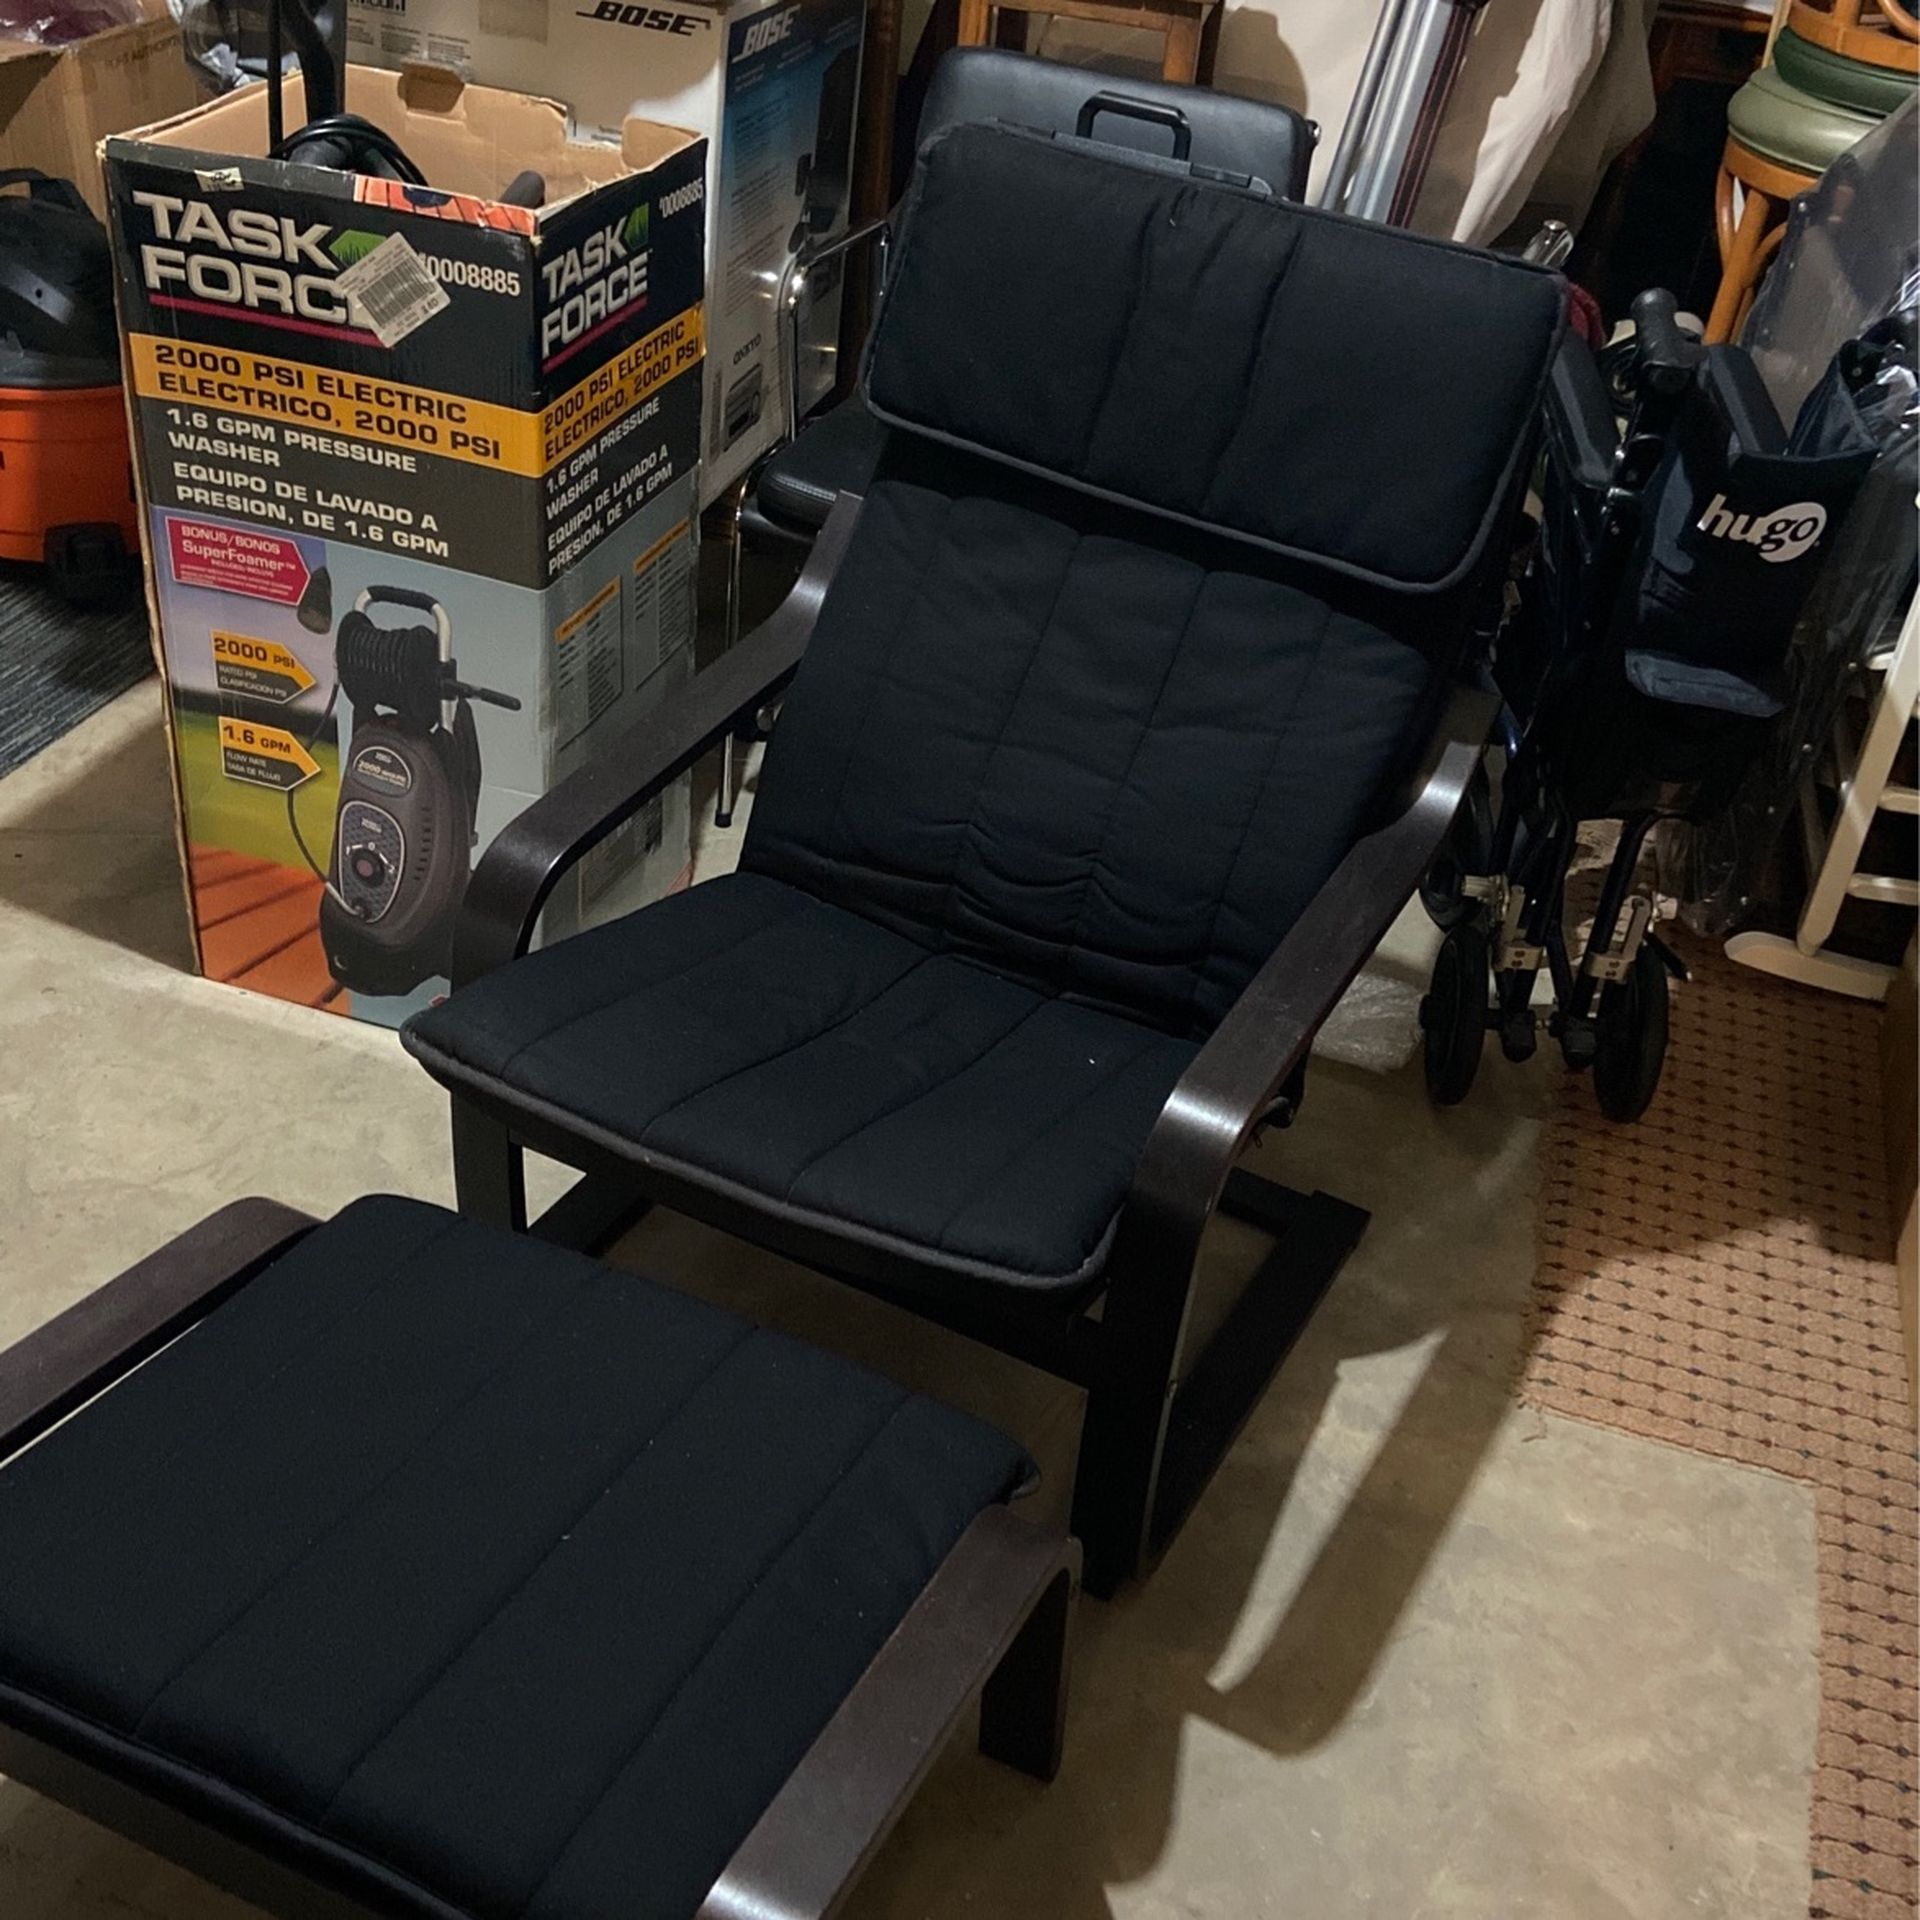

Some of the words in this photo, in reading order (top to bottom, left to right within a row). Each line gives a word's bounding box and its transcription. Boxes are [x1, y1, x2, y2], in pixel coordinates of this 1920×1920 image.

[577, 1, 711, 36] BOSE
[732, 4, 801, 62] BOSE
[132, 190, 339, 271] TASK
[542, 215, 628, 303] TASK
[542, 251, 649, 359] FORCE
[155, 344, 241, 377] 2000
[254, 364, 305, 390] PSI
[317, 375, 467, 424] ELECTRIC
[545, 390, 585, 436] 2000
[589, 367, 613, 402] PSI
[618, 321, 685, 380] ELECTRIC
[545, 388, 629, 463] ELECTRICO,
[634, 354, 671, 397] 2000
[676, 336, 698, 366] PSI
[158, 371, 341, 428] ELECTRICO,
[355, 409, 438, 445] 2000
[450, 431, 501, 460] PSI
[166, 407, 208, 430] 1.6
[216, 416, 276, 443] GPM
[285, 430, 417, 474] PRESSURE
[167, 431, 281, 467] WASHER
[547, 468, 567, 494] 1.6
[570, 443, 597, 478] GPM
[600, 397, 660, 453] PRESSURE
[174, 461, 267, 494] EQUIPO
[275, 481, 308, 503] DE
[316, 489, 413, 526] LAVADO
[420, 513, 438, 533] A
[176, 485, 295, 526] PRESION,
[302, 509, 336, 532] DE
[344, 519, 385, 543] 1.6
[392, 530, 450, 558] GPM
[546, 467, 599, 521] WASHER
[548, 506, 592, 551] EQUIPO
[595, 488, 610, 511] DE
[613, 451, 657, 497] LAVADO
[659, 444, 669, 462] A
[549, 519, 604, 575] PRESION,
[607, 502, 622, 526] DE
[625, 485, 644, 509] 1.6
[646, 462, 673, 493] GPM
[1697, 493, 1824, 560] hugo
[181, 525, 281, 555] BONUS/BONOS
[214, 637, 268, 662] 2000
[273, 654, 296, 669] PSI
[223, 724, 255, 745] 1.6
[260, 737, 291, 754] GPM
